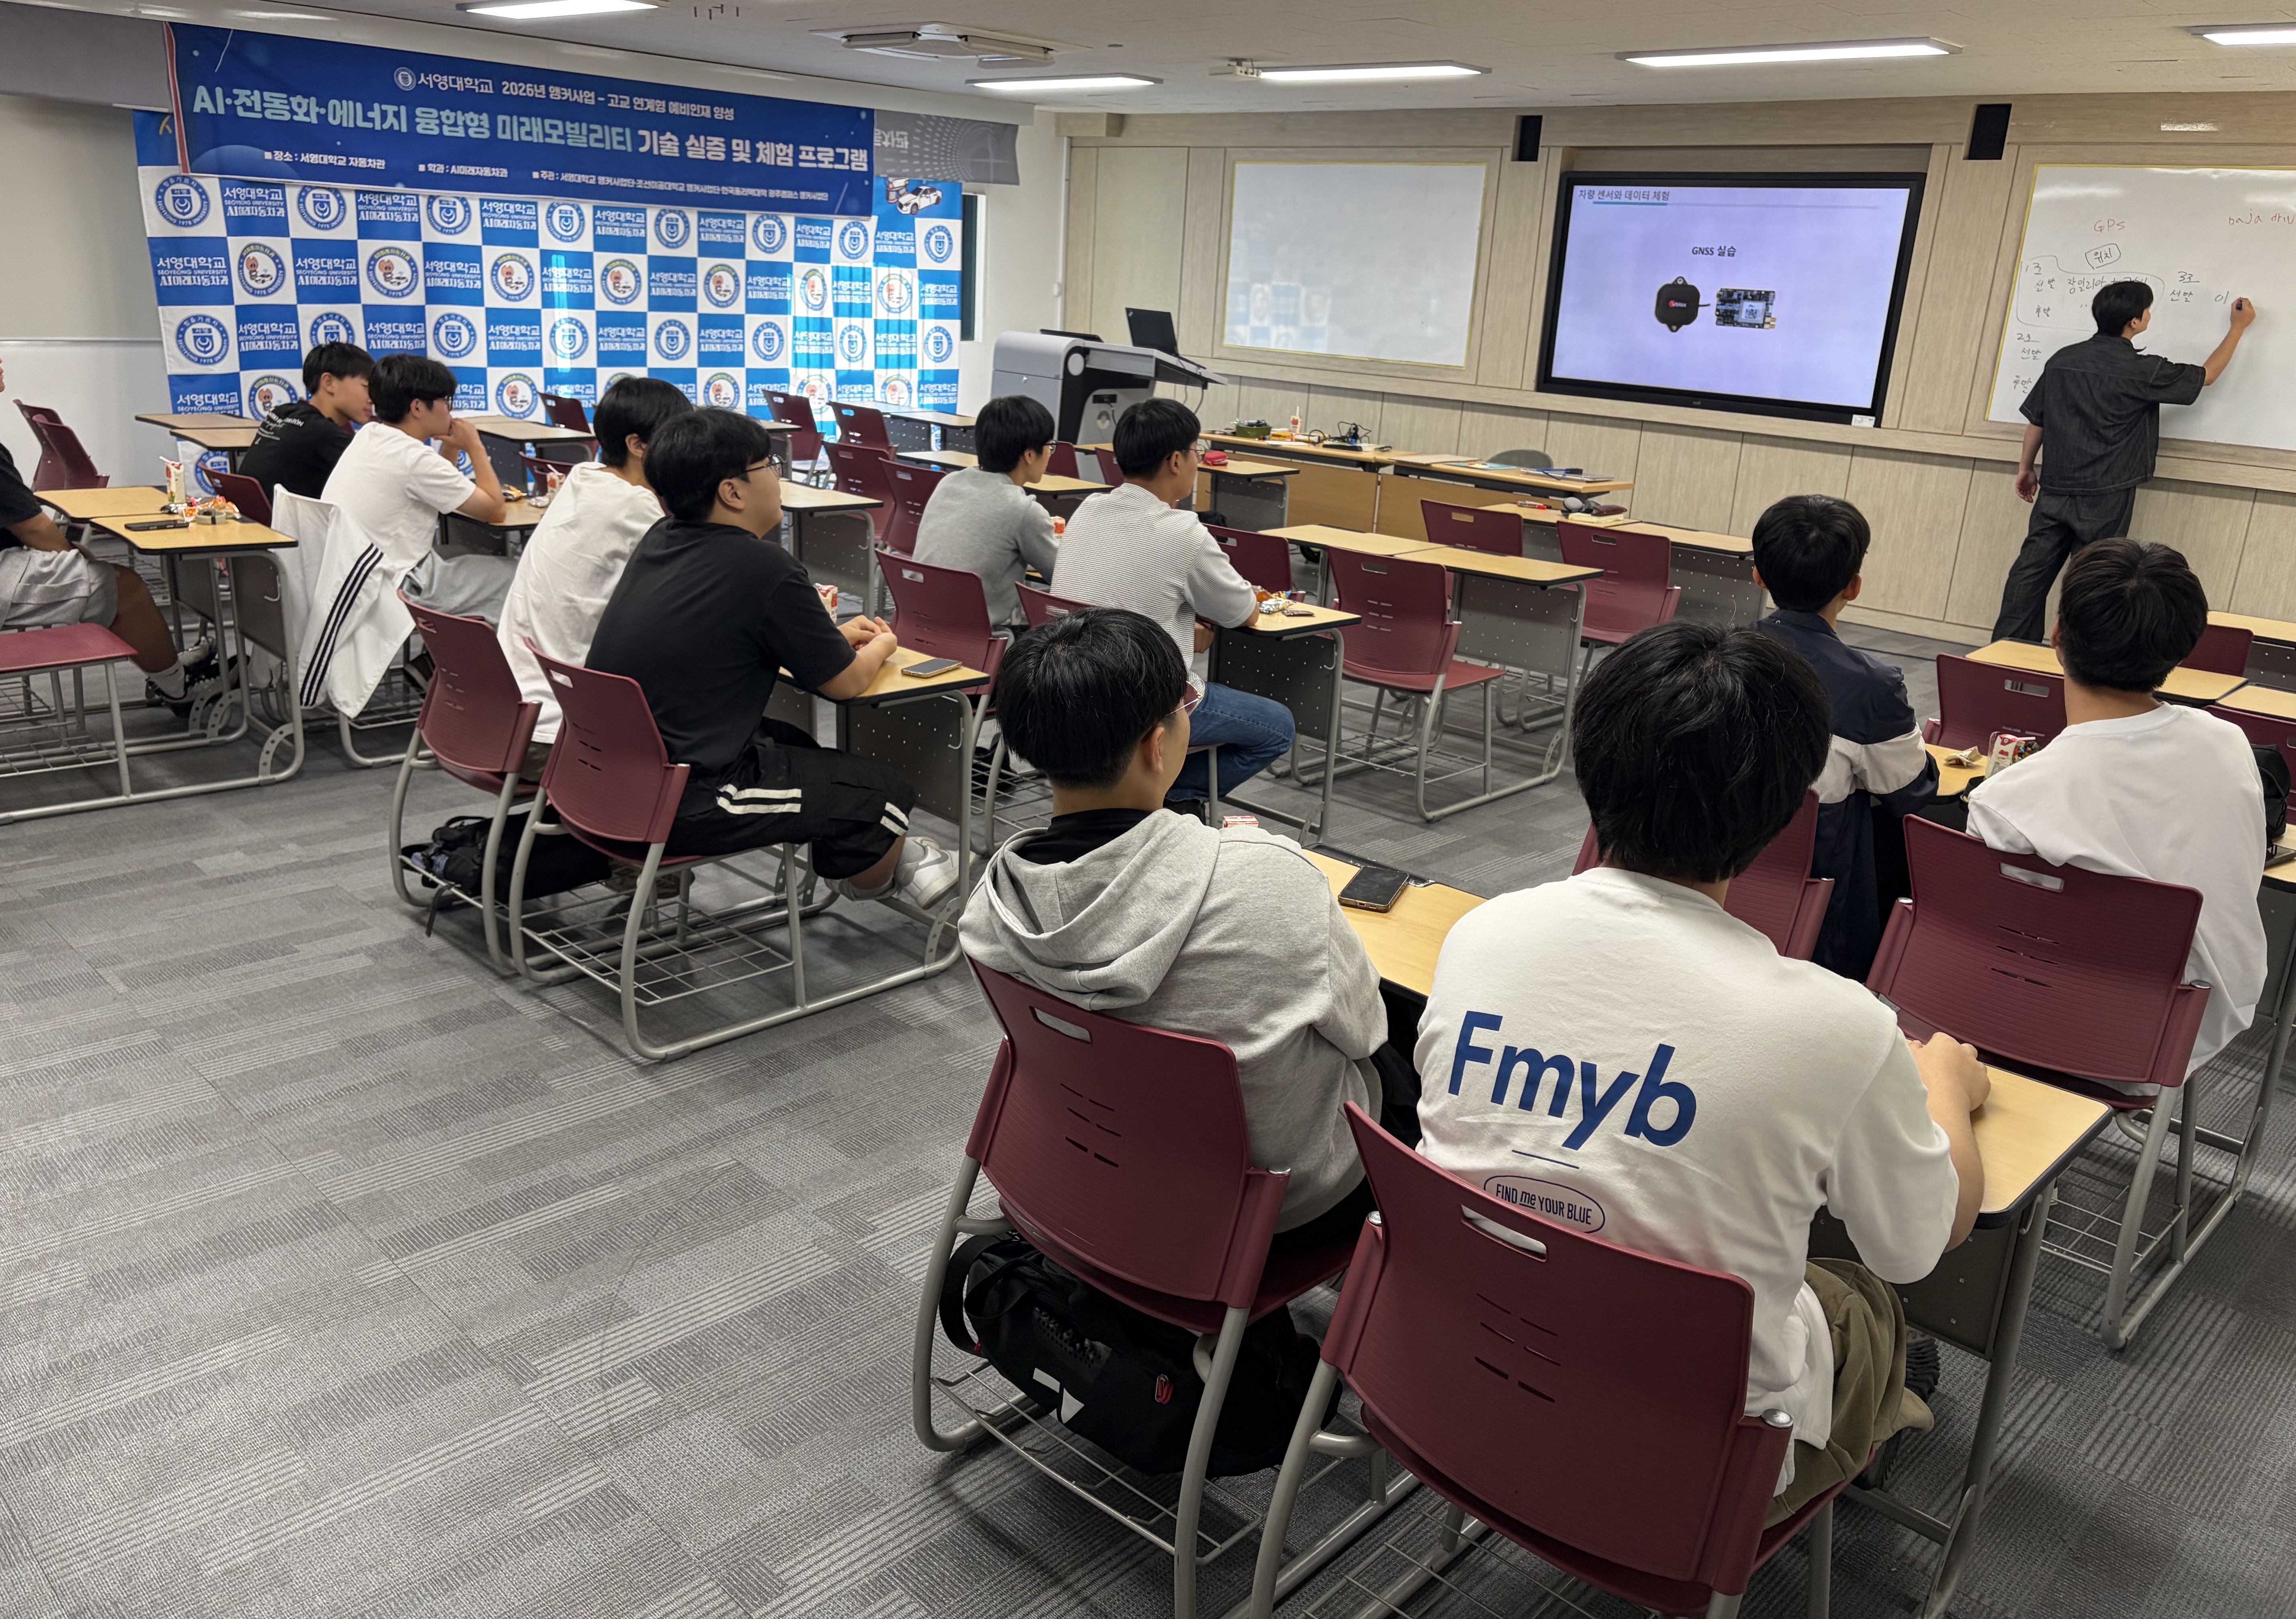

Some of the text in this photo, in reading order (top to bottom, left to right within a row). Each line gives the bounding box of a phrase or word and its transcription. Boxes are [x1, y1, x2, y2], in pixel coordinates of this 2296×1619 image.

[418, 72, 494, 94] 서영대학교
[502, 80, 546, 98] 2026년
[549, 86, 595, 105] 앵커사업
[607, 93, 631, 109] 고교
[633, 96, 666, 114] 연계형
[668, 101, 711, 119] 예비인재
[713, 107, 735, 121] 양성
[192, 85, 869, 172] AI·전동화·에너지 융합형 미래모빌리티 기술 실증 및 체험 프로그램
[274, 150, 293, 161] 장소
[300, 153, 347, 166] 서영대학교
[348, 156, 386, 170] 자동차관
[427, 163, 445, 174] 학과
[223, 187, 283, 201] 서영대학교
[357, 193, 418, 207] 서영대학교
[1579, 189, 1670, 201] 차량 센서와 데이터 체험
[227, 205, 285, 217] AI미래자동차과
[482, 201, 536, 216] 서영대학교
[595, 210, 645, 224] 서영대학교
[1692, 245, 1736, 257] GNSS 실습
[2094, 247, 2112, 264] 위치
[157, 257, 227, 270] 서영대학교
[295, 258, 357, 271] 서영대학교
[425, 260, 481, 275] 서영대학교
[542, 266, 592, 279] 서영대학교
[160, 275, 229, 285] AI미래자동차과
[297, 275, 357, 286] AI미래자동차과
[238, 322, 297, 335] 서영대학교
[367, 323, 425, 334] 서영대학교
[488, 325, 540, 336] 서영대학교
[598, 327, 646, 338] 서영대학교
[240, 340, 299, 351] AI미래자동차과
[369, 339, 426, 349] AI미래자동차과
[177, 392, 239, 405] 서영대학교
[1448, 1010, 1697, 1151] Fmyb
[1496, 1183, 1592, 1225] FIND me YOUR BLUE
